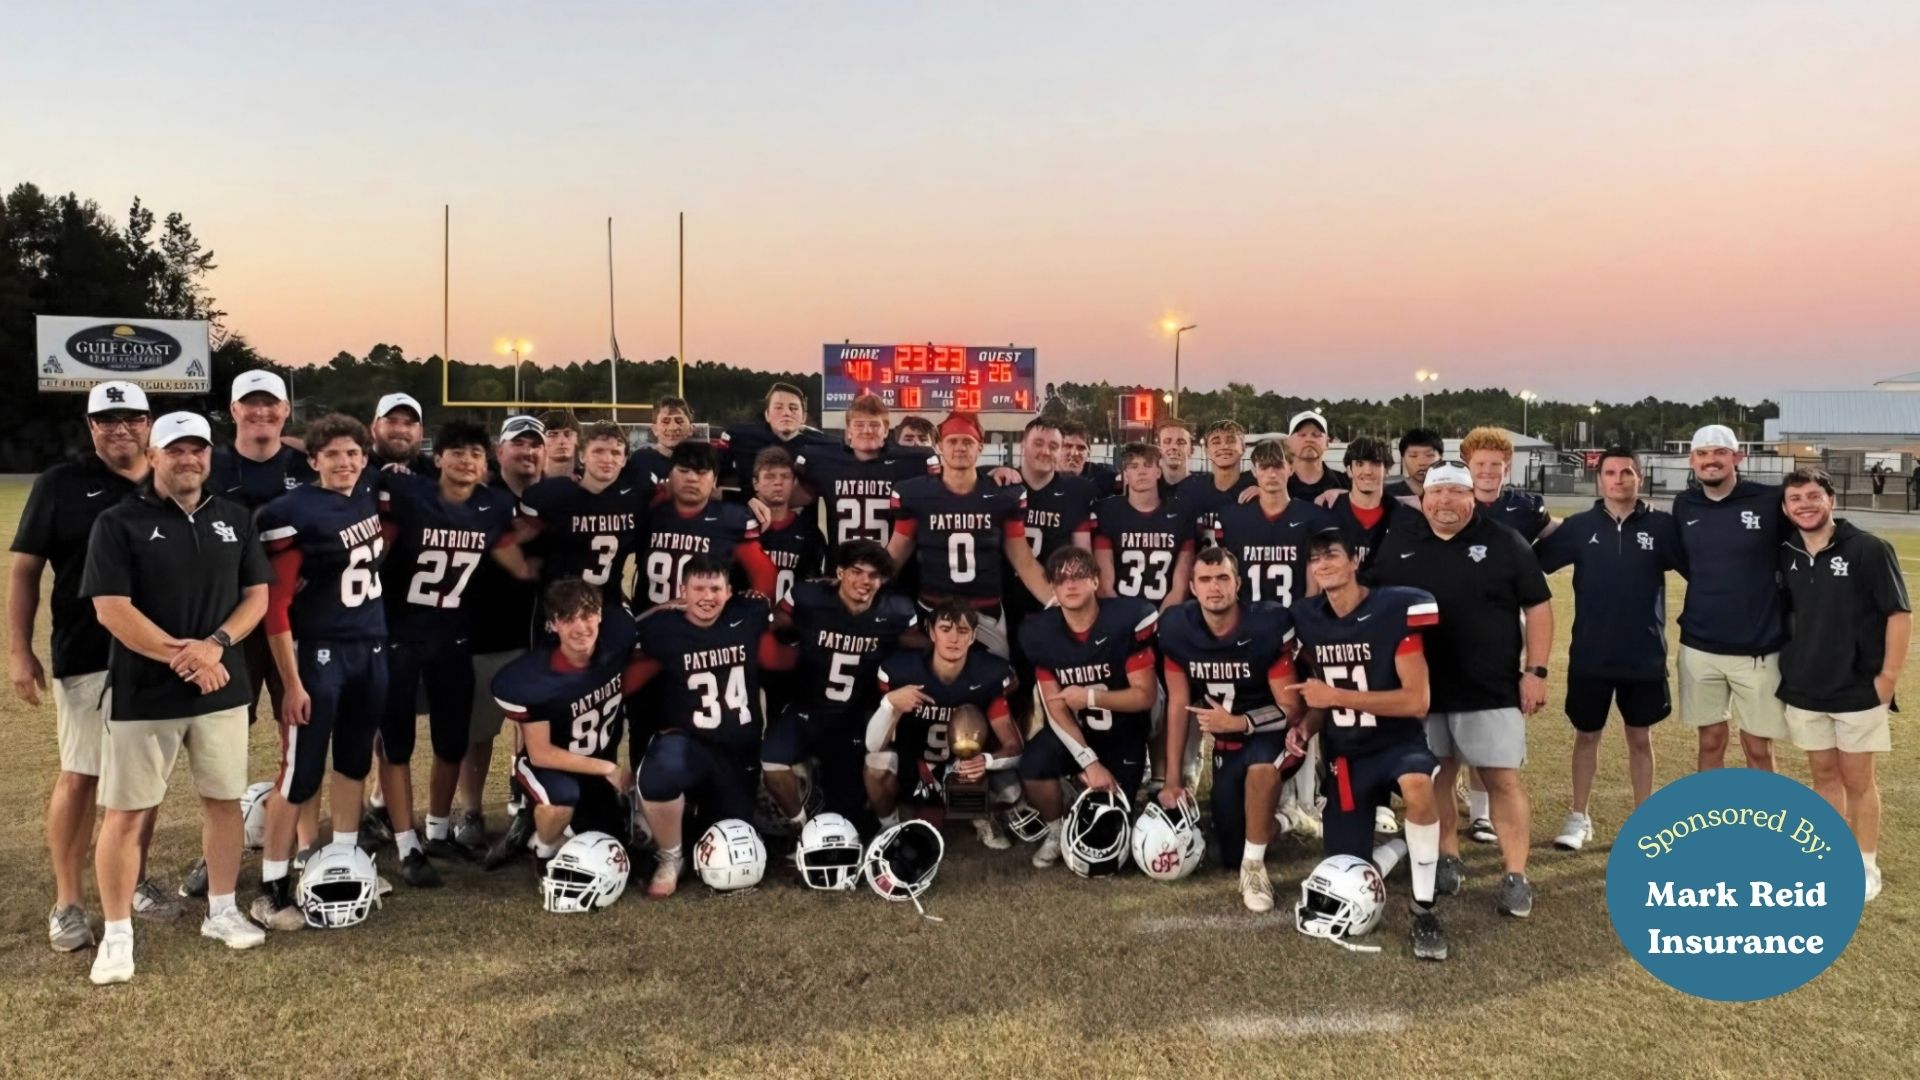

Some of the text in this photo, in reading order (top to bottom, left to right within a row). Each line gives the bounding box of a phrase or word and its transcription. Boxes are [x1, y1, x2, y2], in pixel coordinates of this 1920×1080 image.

[76, 341, 172, 356] GULF COAST
[840, 348, 880, 360] HOME
[979, 351, 1021, 363] GUEST
[895, 346, 965, 372] 23:23
[847, 361, 873, 381] 40
[880, 367, 892, 384] 3
[968, 369, 979, 385] 3
[988, 363, 1012, 383] 26
[901, 387, 921, 408] 10
[956, 389, 981, 408] 20
[1015, 389, 1028, 409] 4
[1135, 395, 1152, 420] 0
[834, 479, 892, 496] PATRIOTS
[572, 514, 635, 533] PATRIOTS
[836, 498, 891, 548] 25
[930, 513, 992, 531] PATRIOTS
[1740, 510, 1761, 530] SH
[422, 528, 486, 549] PATRIOTS
[650, 532, 711, 553] PATRIOTS
[1121, 532, 1175, 549] PATRIOTS
[1636, 532, 1655, 550] SH
[582, 535, 619, 585] 3
[949, 532, 976, 583] 0
[1243, 546, 1297, 562] PATRIOTS
[406, 550, 482, 608] 27
[1118, 550, 1173, 600] 33
[1247, 564, 1293, 608] 13
[818, 629, 879, 653] PATRIOTS
[684, 645, 746, 671] PATRIOTS
[1315, 643, 1372, 663] PATRIOTS
[825, 652, 860, 702] 5
[1189, 661, 1251, 680] PATRIOTS
[570, 672, 622, 717] PATRIOTS
[687, 665, 752, 729] 34
